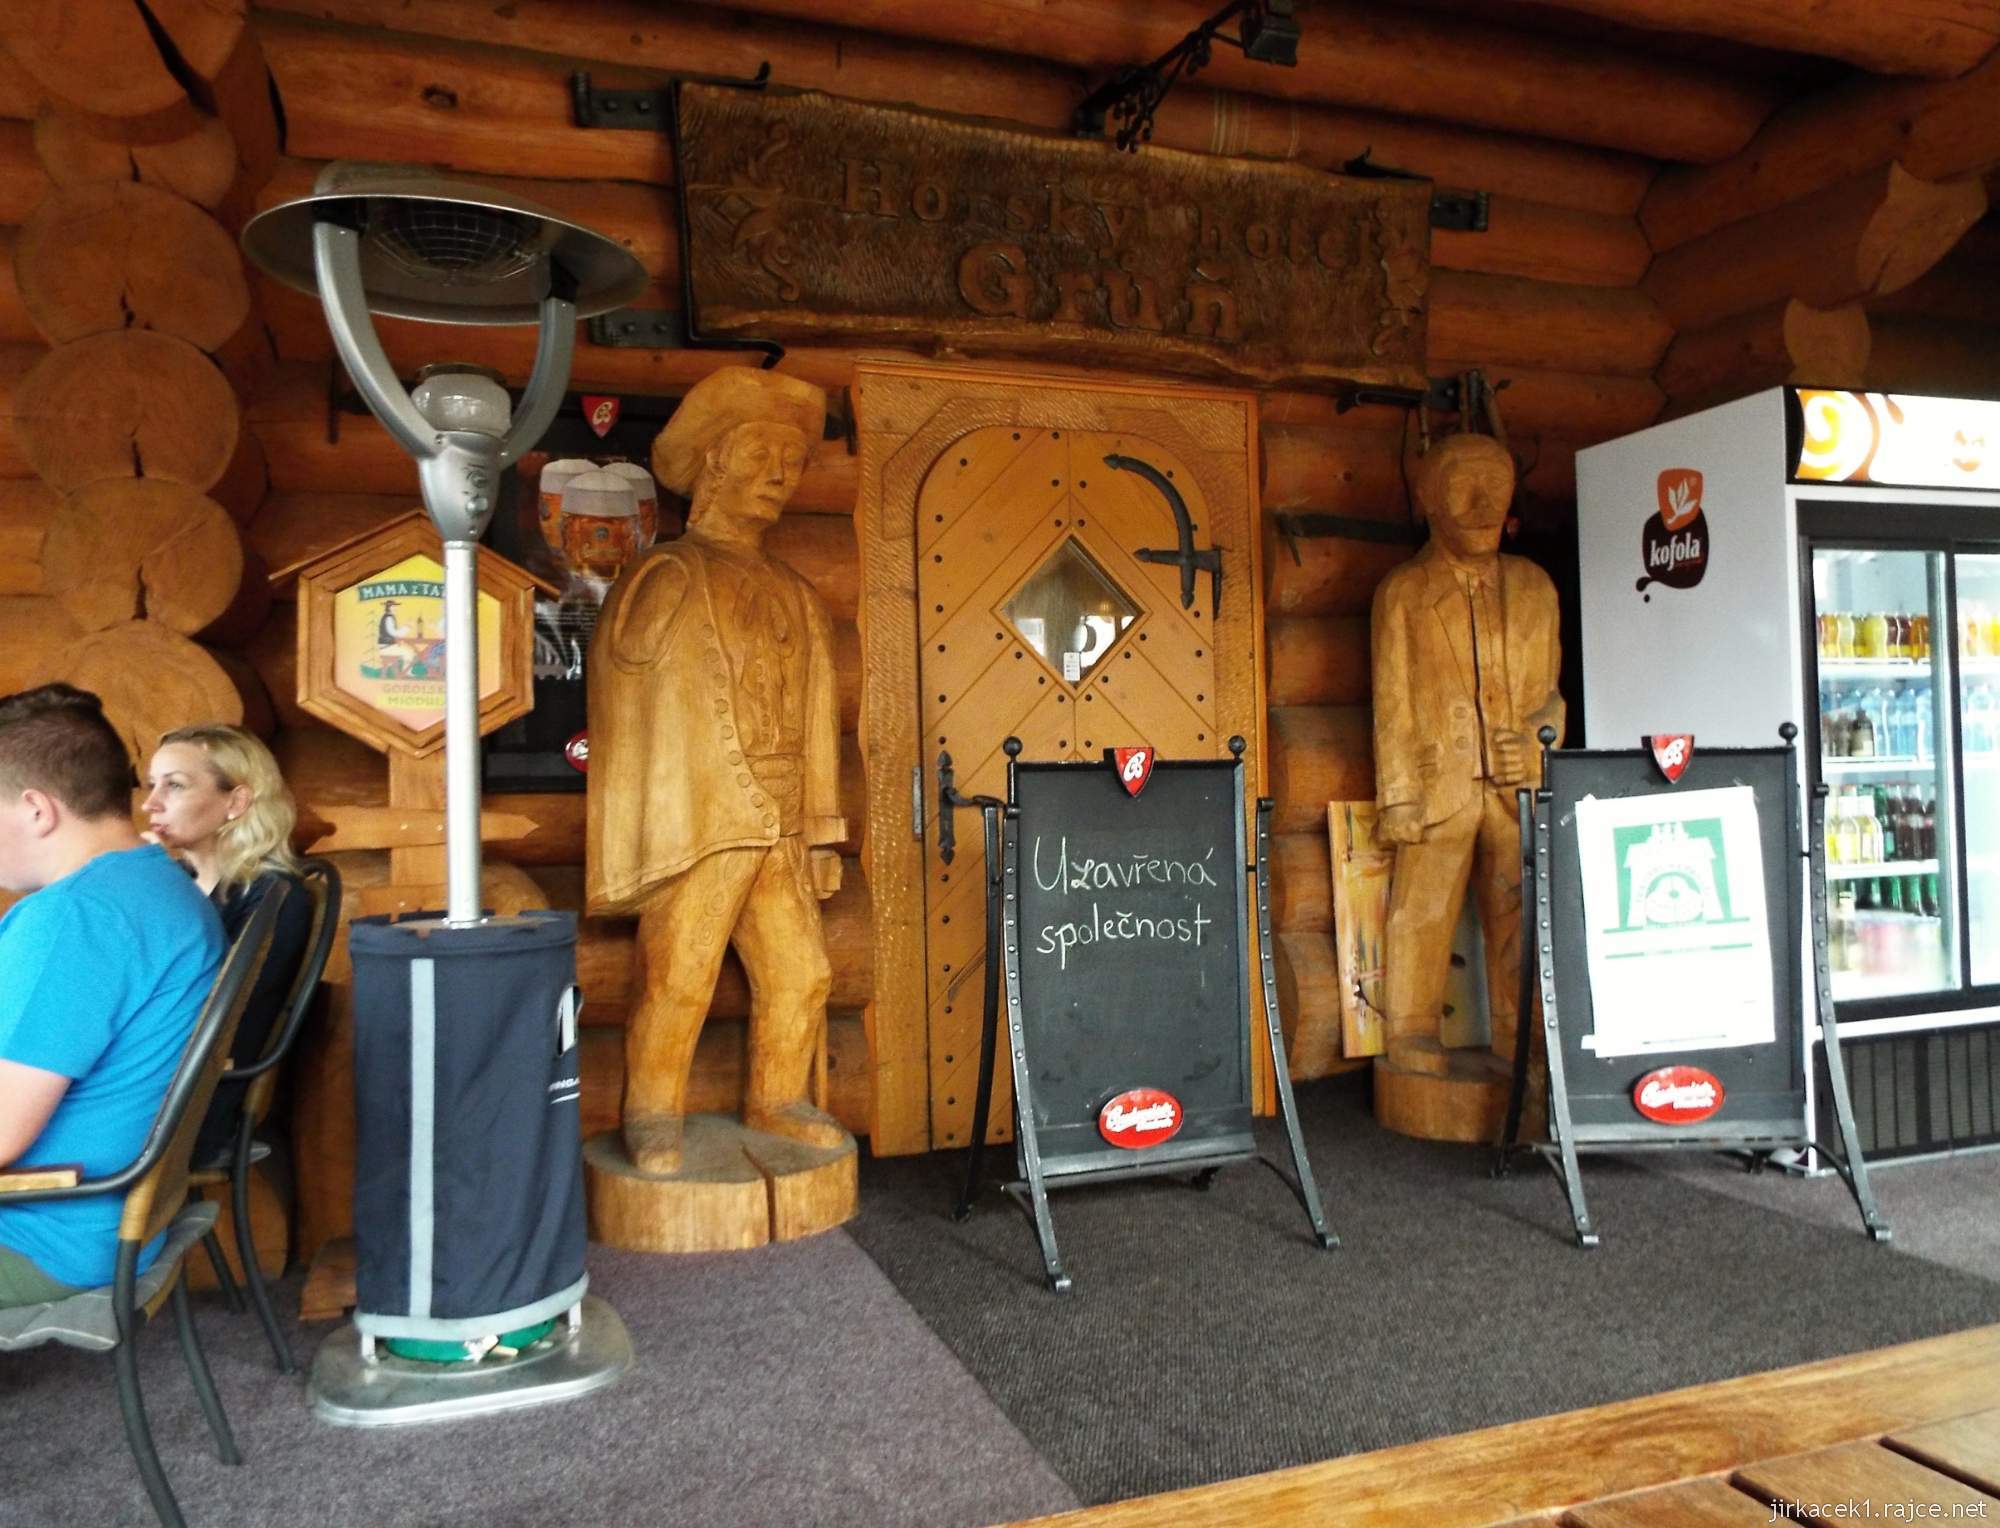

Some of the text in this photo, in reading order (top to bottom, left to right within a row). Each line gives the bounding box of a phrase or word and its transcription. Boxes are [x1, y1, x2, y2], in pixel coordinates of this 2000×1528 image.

[1197, 203, 1375, 271] hotel
[1649, 531, 1701, 571] kofola
[362, 583, 408, 599] MAMA
[1034, 836, 1217, 894] Uzavřená
[1036, 902, 1212, 970] společnost
